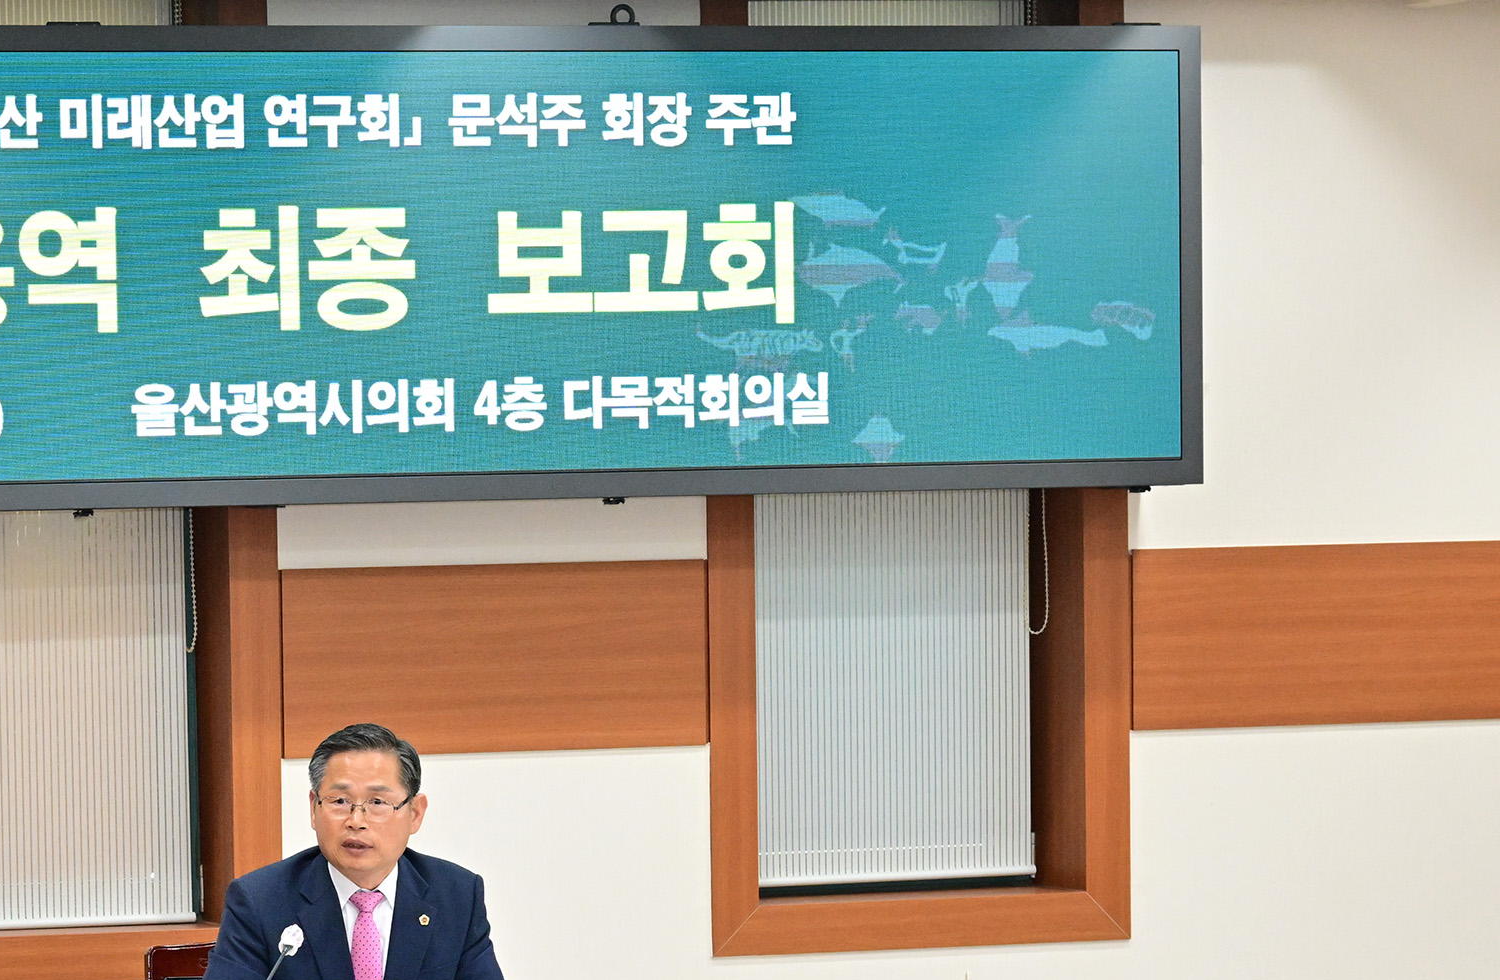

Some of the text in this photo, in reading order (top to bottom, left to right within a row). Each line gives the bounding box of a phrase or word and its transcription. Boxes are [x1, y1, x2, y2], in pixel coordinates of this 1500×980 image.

[60, 93, 244, 149] 미래산업
[263, 93, 422, 148] 연구회」
[447, 92, 587, 148] 문석주
[602, 92, 692, 148] 회장
[705, 92, 797, 146] 주관
[199, 205, 415, 331] 최종
[487, 202, 795, 325] 보고회
[131, 371, 830, 438] 울산광역시의회 4층 다목적회의실
